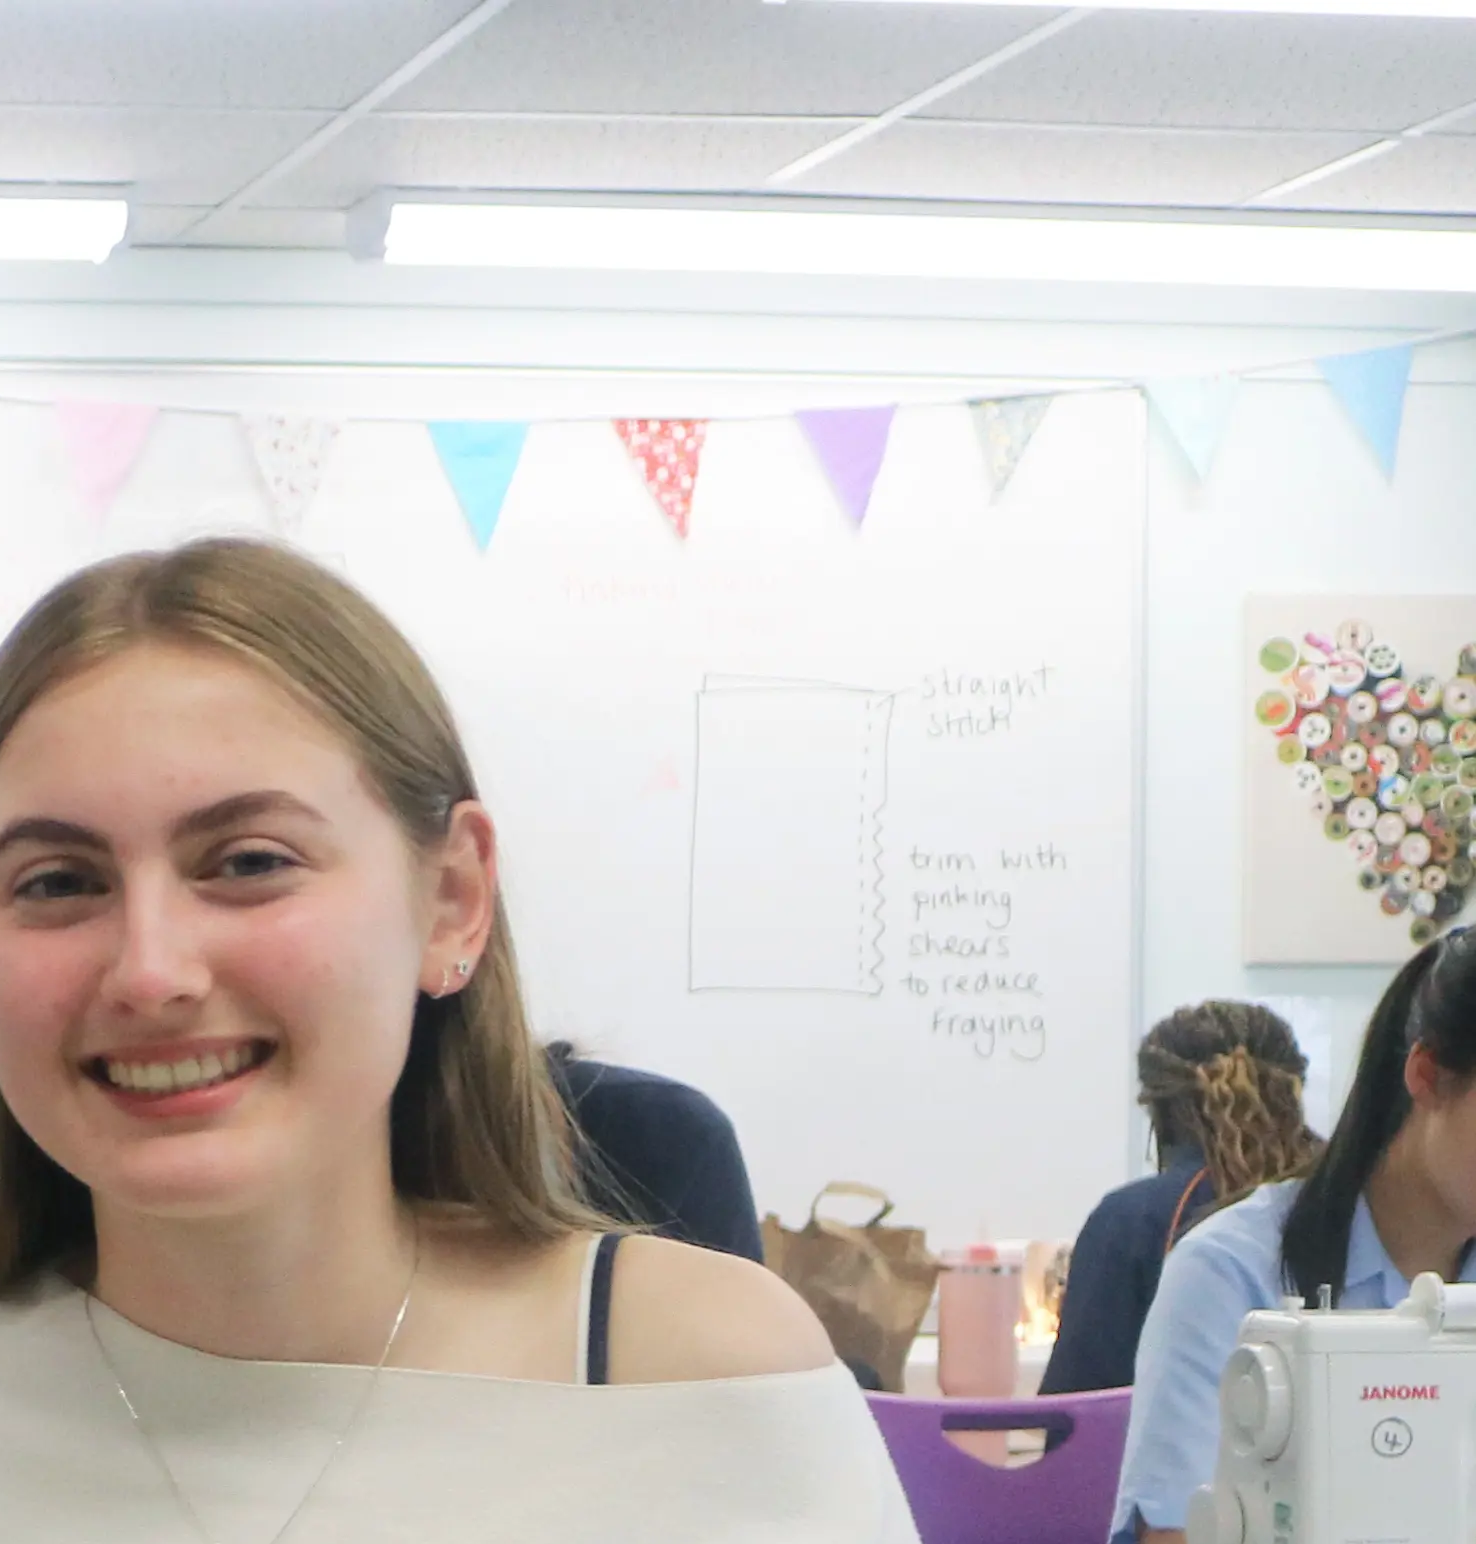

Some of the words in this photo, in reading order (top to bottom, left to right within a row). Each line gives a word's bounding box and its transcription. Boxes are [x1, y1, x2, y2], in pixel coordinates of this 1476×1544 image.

[908, 843, 976, 872] trim
[1000, 842, 1068, 871] with
[912, 884, 1012, 930] pinking
[908, 931, 1010, 959] shears
[898, 971, 930, 997] to
[941, 971, 1044, 998] reduce
[1359, 1384, 1441, 1401] JANOME
